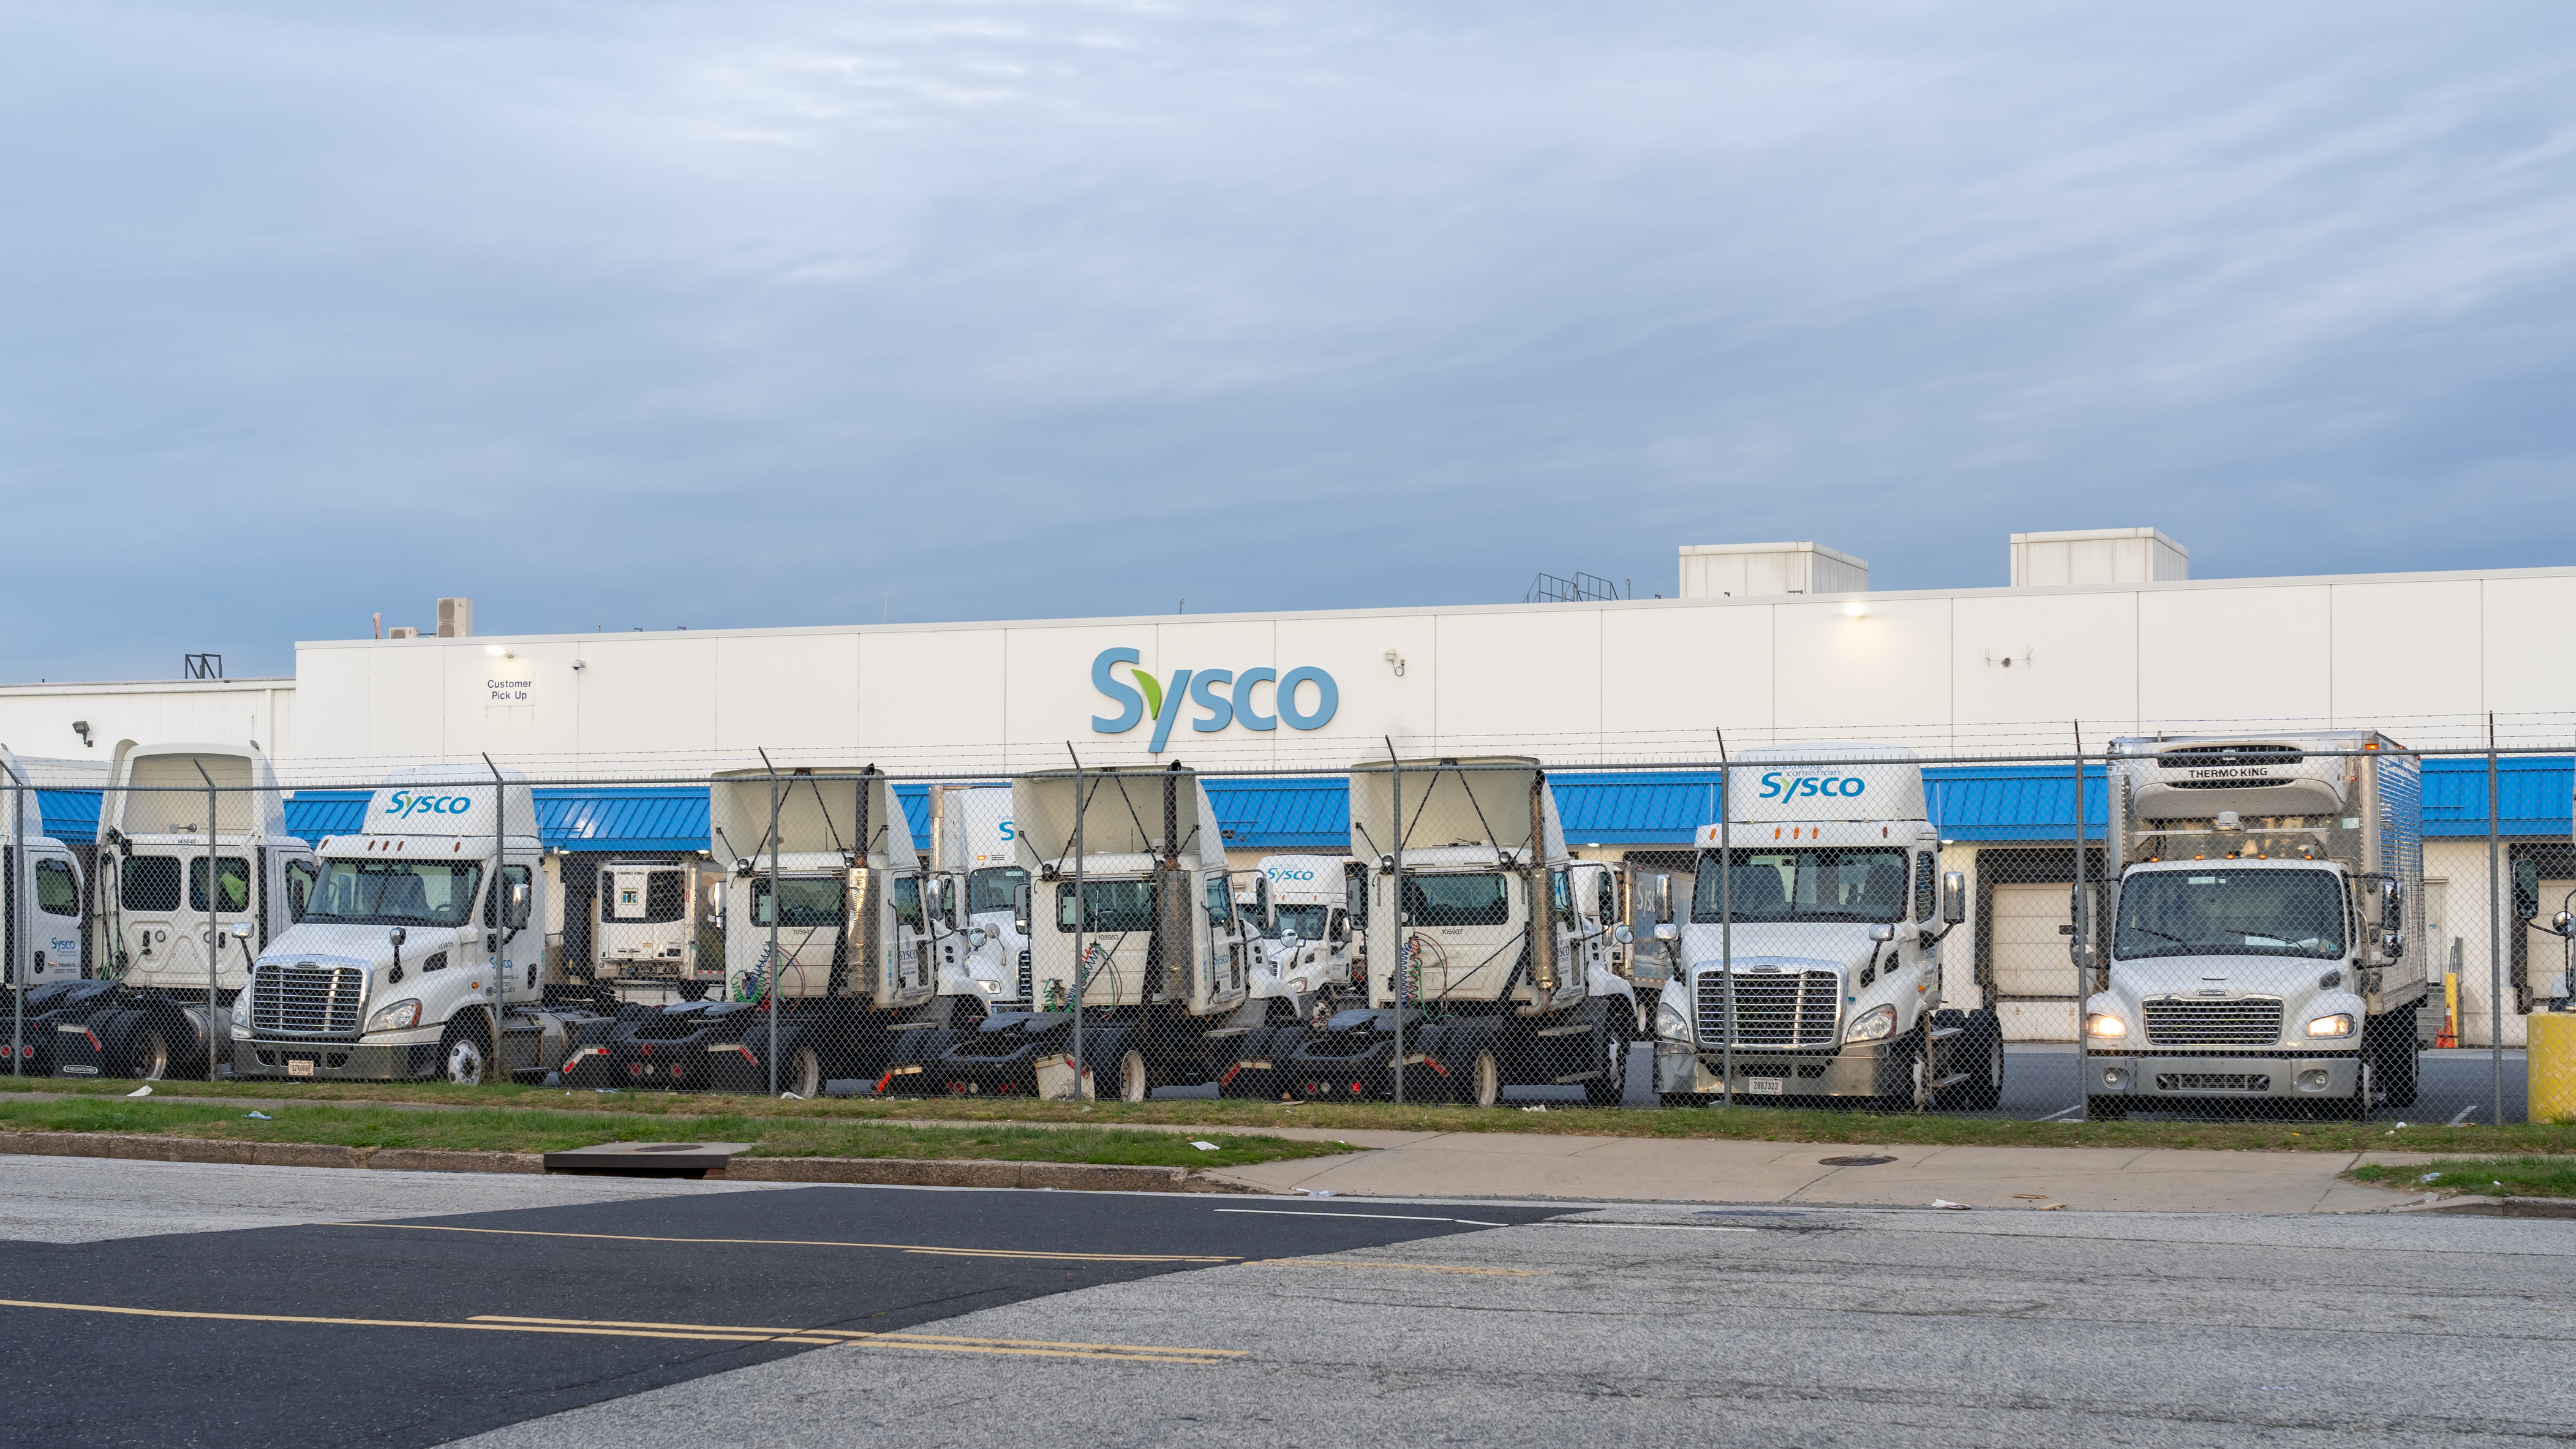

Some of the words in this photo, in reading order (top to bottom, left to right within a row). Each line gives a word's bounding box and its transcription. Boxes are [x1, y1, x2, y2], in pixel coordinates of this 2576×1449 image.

[488, 679, 532, 688] Customer
[492, 691, 511, 699] Pick
[514, 691, 527, 701] Up
[1091, 647, 1339, 753] Sysco
[2189, 769, 2238, 778] THERMO
[2240, 768, 2268, 777] KING
[1759, 772, 1865, 804] Sysco
[385, 791, 471, 819] Sysco
[1267, 867, 1314, 883] Sysco
[51, 937, 75, 952] Sysco
[899, 949, 918, 961] SYSCO
[1214, 953, 1229, 968] Sysco
